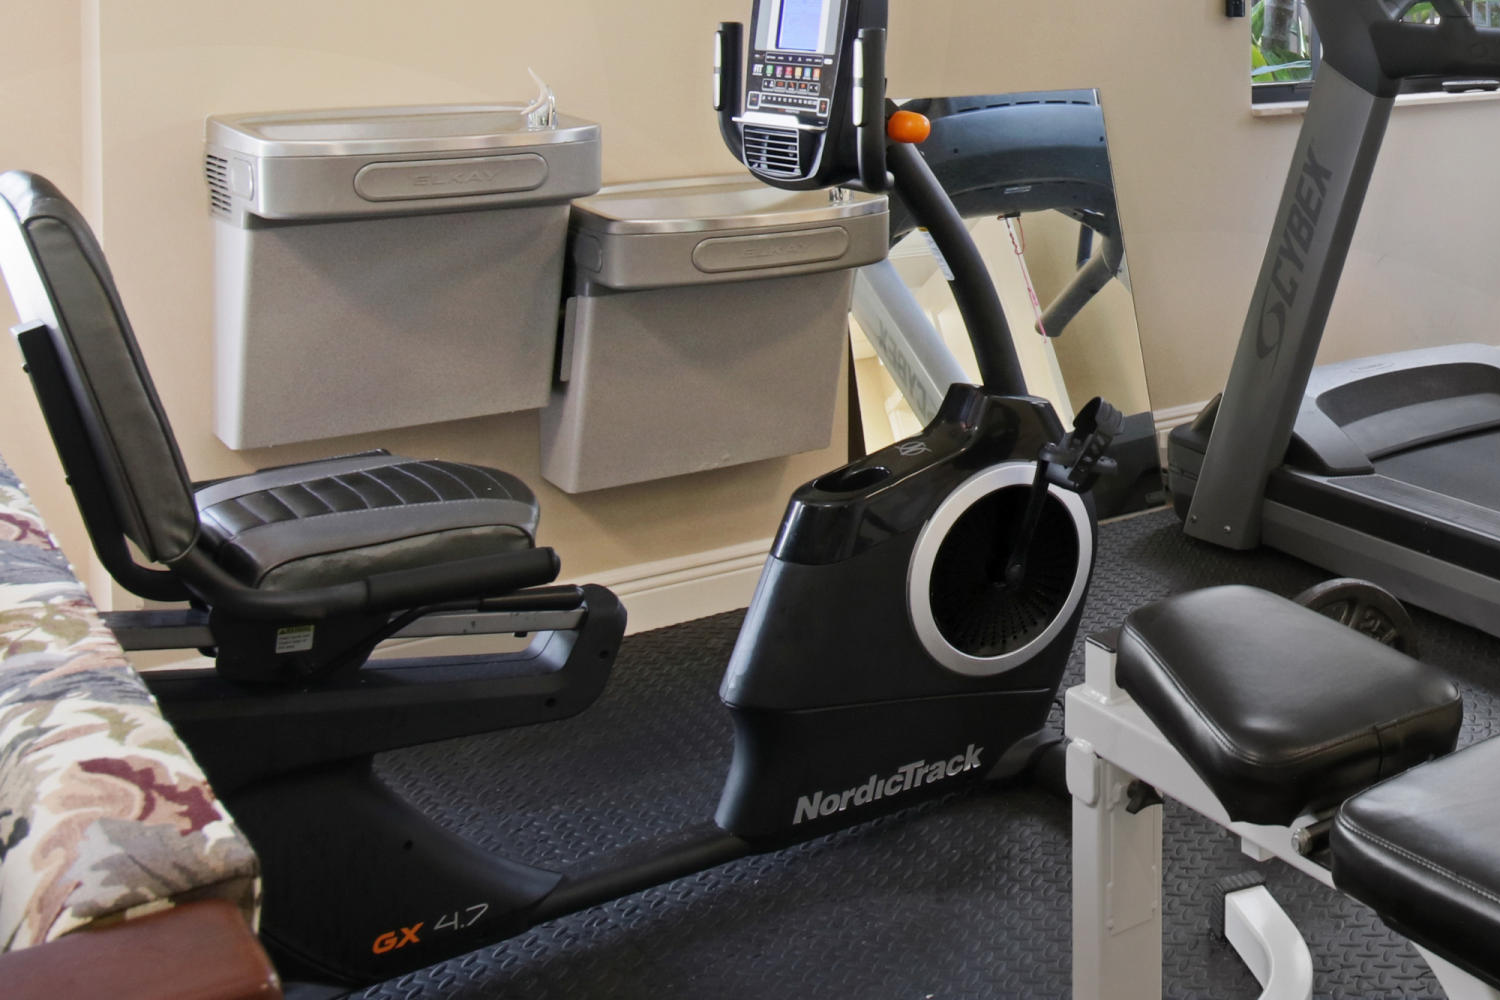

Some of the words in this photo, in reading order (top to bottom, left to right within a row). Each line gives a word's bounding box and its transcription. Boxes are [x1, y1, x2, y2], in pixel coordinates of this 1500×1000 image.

[1271, 144, 1333, 309] CYBEX
[792, 744, 984, 825] NordicTrack
[372, 921, 424, 955] GX
[433, 903, 489, 930] 4.7
